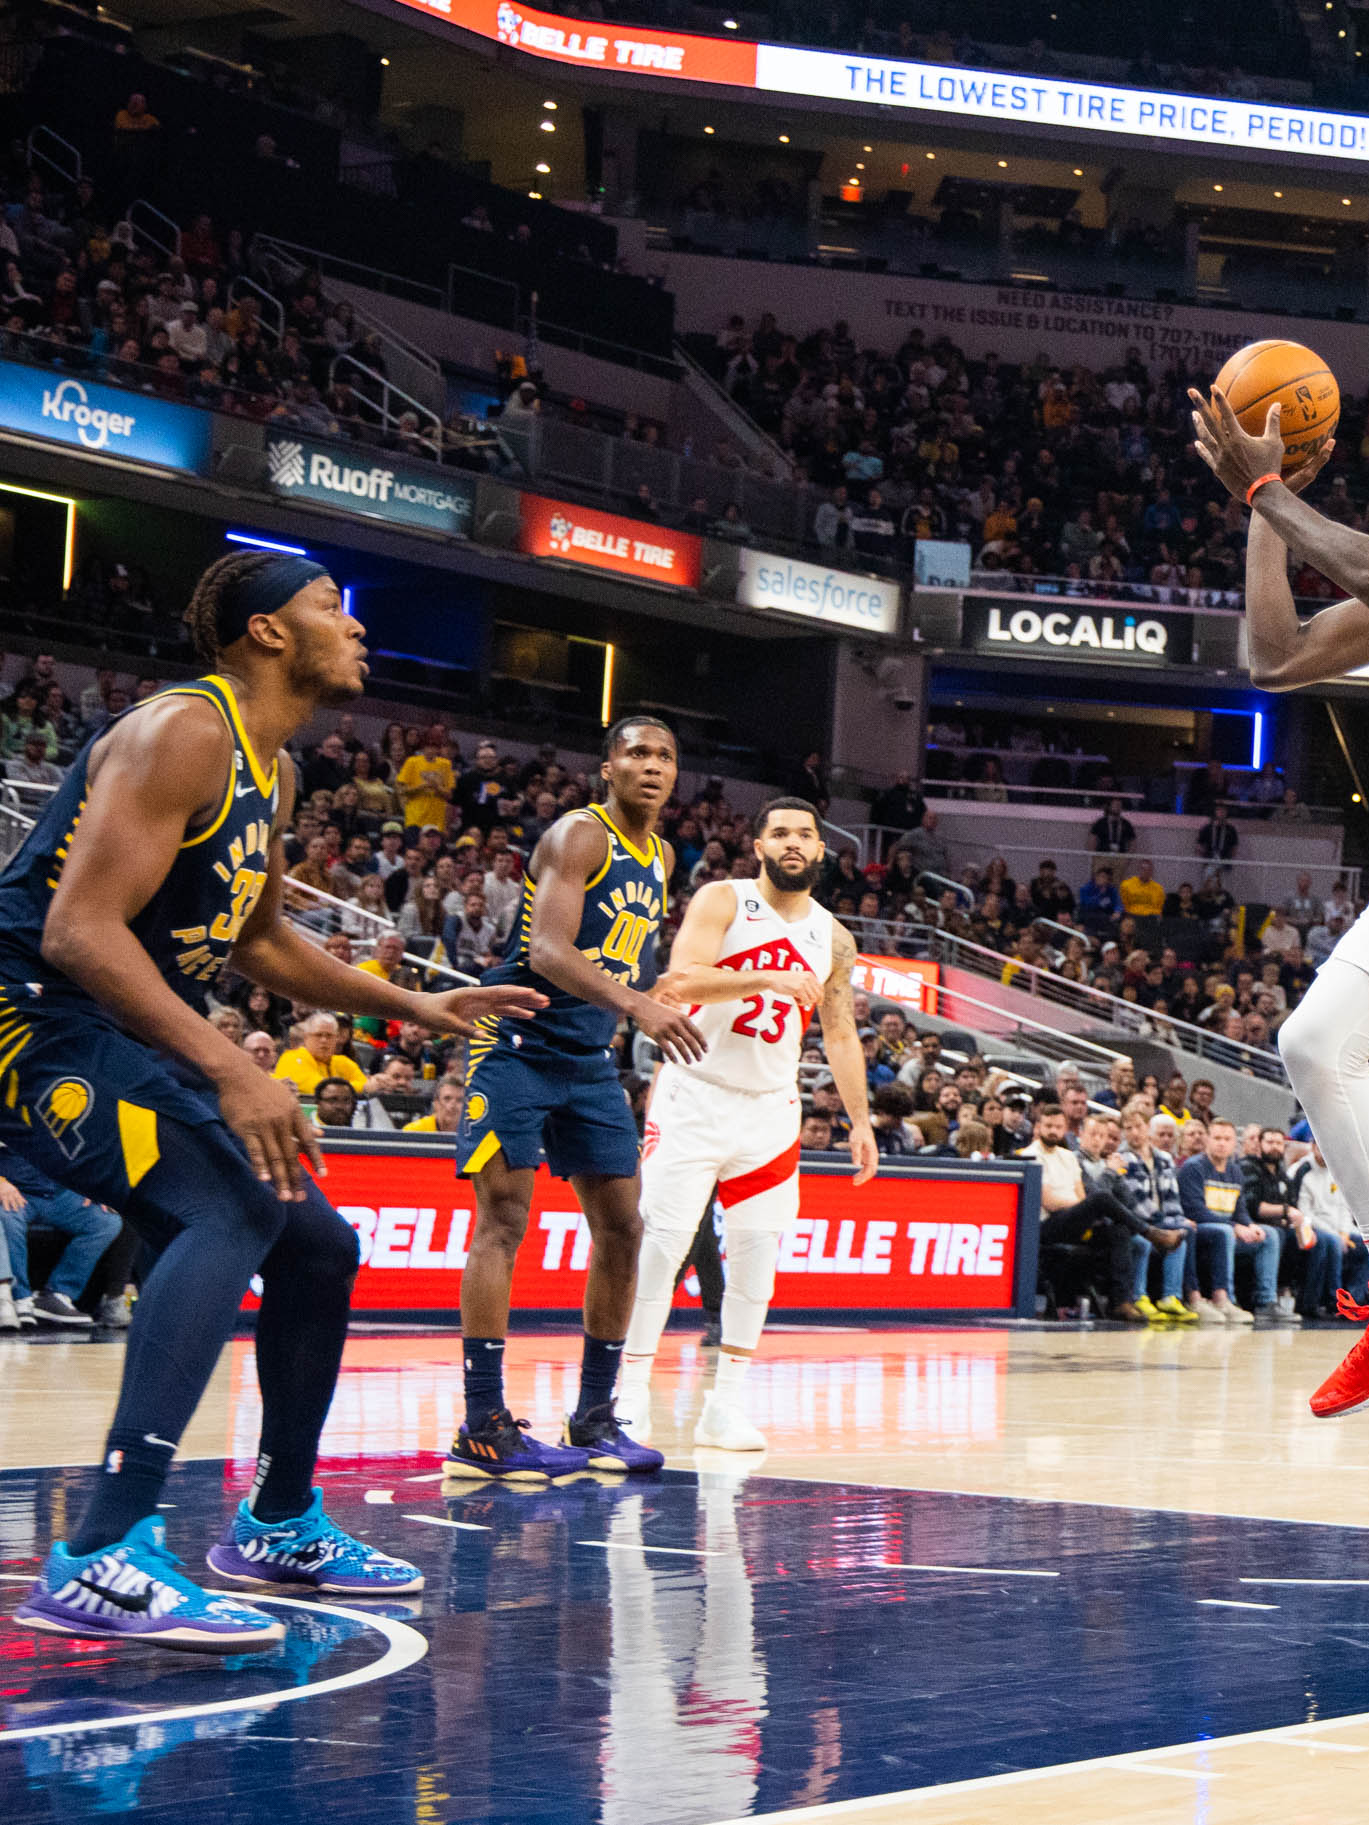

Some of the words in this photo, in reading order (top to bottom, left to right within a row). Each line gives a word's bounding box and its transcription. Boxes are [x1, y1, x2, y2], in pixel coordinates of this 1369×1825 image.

[520, 21, 608, 60] BELLE
[614, 40, 685, 70] TIRE
[845, 65, 907, 96] THE
[919, 74, 1047, 112] LOWEST
[1057, 91, 1125, 122] TIRE
[1138, 101, 1236, 140] PRICE,
[1248, 114, 1366, 150] PERIOD!
[885, 300, 926, 321] TEXT
[931, 303, 966, 324] THE
[970, 306, 1022, 328] ISSUE
[1044, 316, 1129, 338] LOCATION
[1134, 324, 1156, 341] TO
[997, 288, 1045, 309] NEED
[42, 380, 135, 448] Kroger
[310, 452, 394, 501] Ruoff
[394, 484, 471, 516] MORTGAGE
[571, 528, 628, 557] BELLE
[633, 541, 676, 569] TIRE
[757, 564, 883, 618] salesforce
[602, 910, 650, 966] 00
[732, 993, 793, 1044] 23
[337, 1206, 471, 1270] BELL
[777, 1218, 897, 1274] ELLE
[907, 1222, 1009, 1276] TIRE
